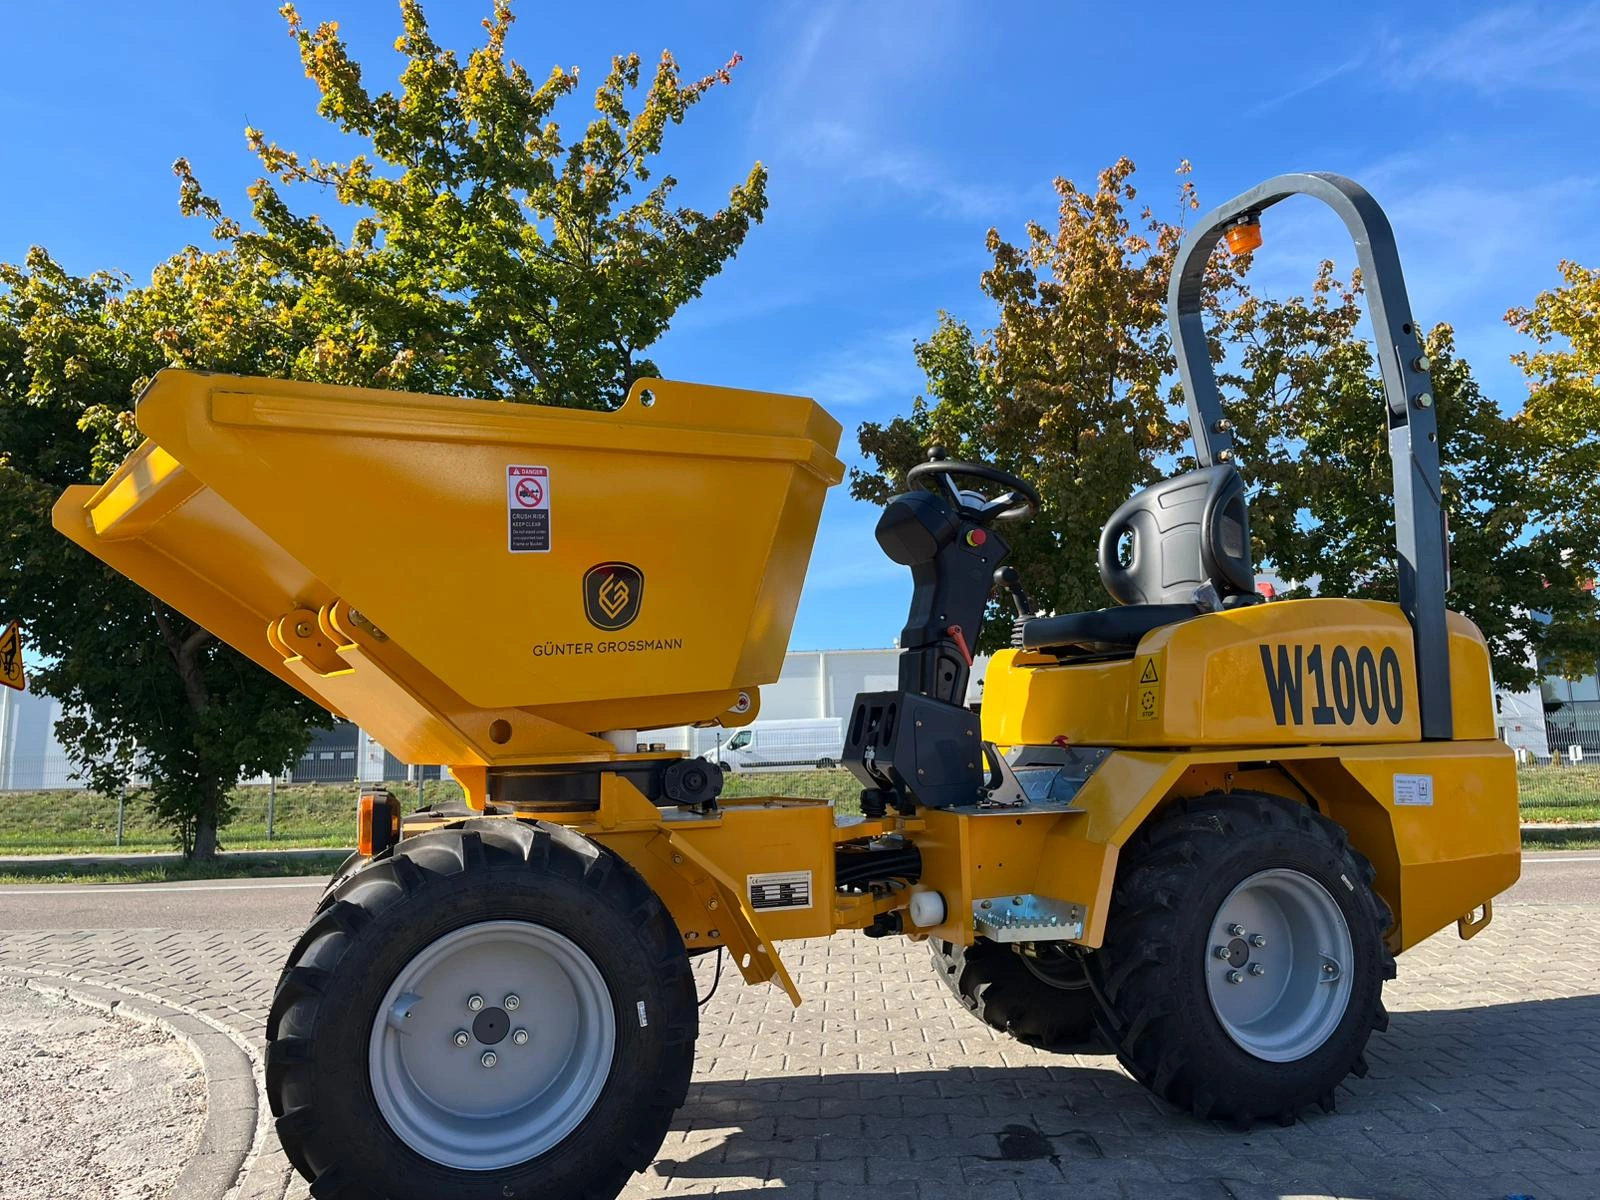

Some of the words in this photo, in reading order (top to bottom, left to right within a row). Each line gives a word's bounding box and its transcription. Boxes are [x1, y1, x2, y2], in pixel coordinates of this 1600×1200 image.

[532, 641, 594, 657] GÜNTER
[597, 638, 683, 654] GROSSMANN
[1259, 644, 1403, 725] W1000
